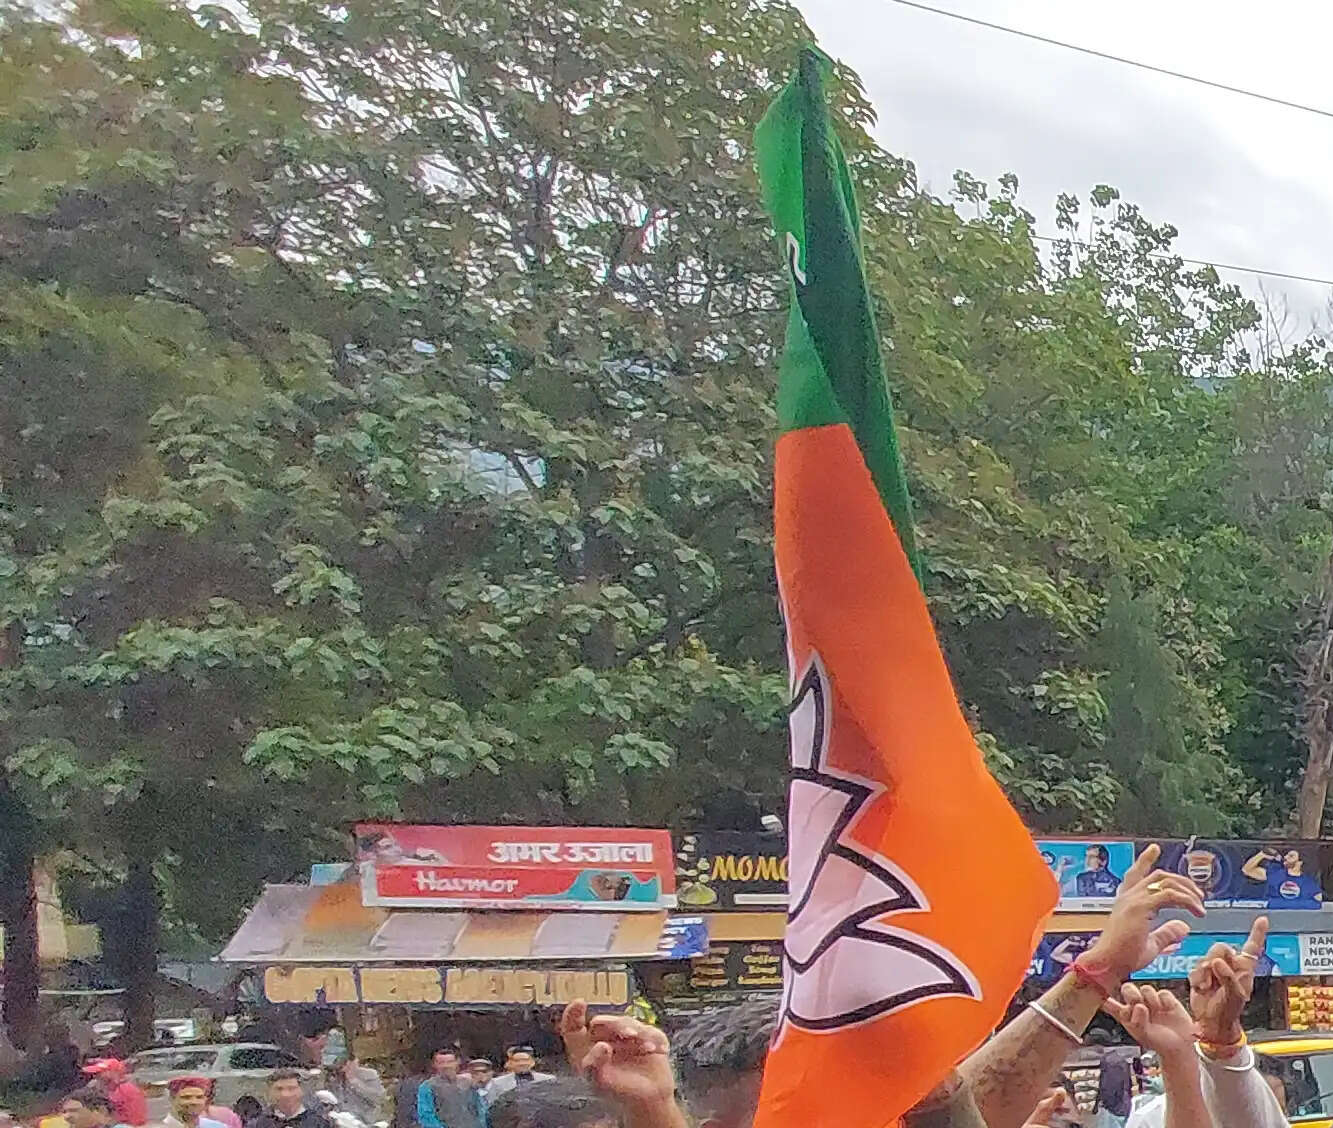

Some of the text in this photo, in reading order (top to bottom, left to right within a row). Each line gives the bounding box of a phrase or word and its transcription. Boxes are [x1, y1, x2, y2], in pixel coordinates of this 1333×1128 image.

[487, 842, 653, 863] अमर उजाला
[415, 870, 519, 893] Havmor
